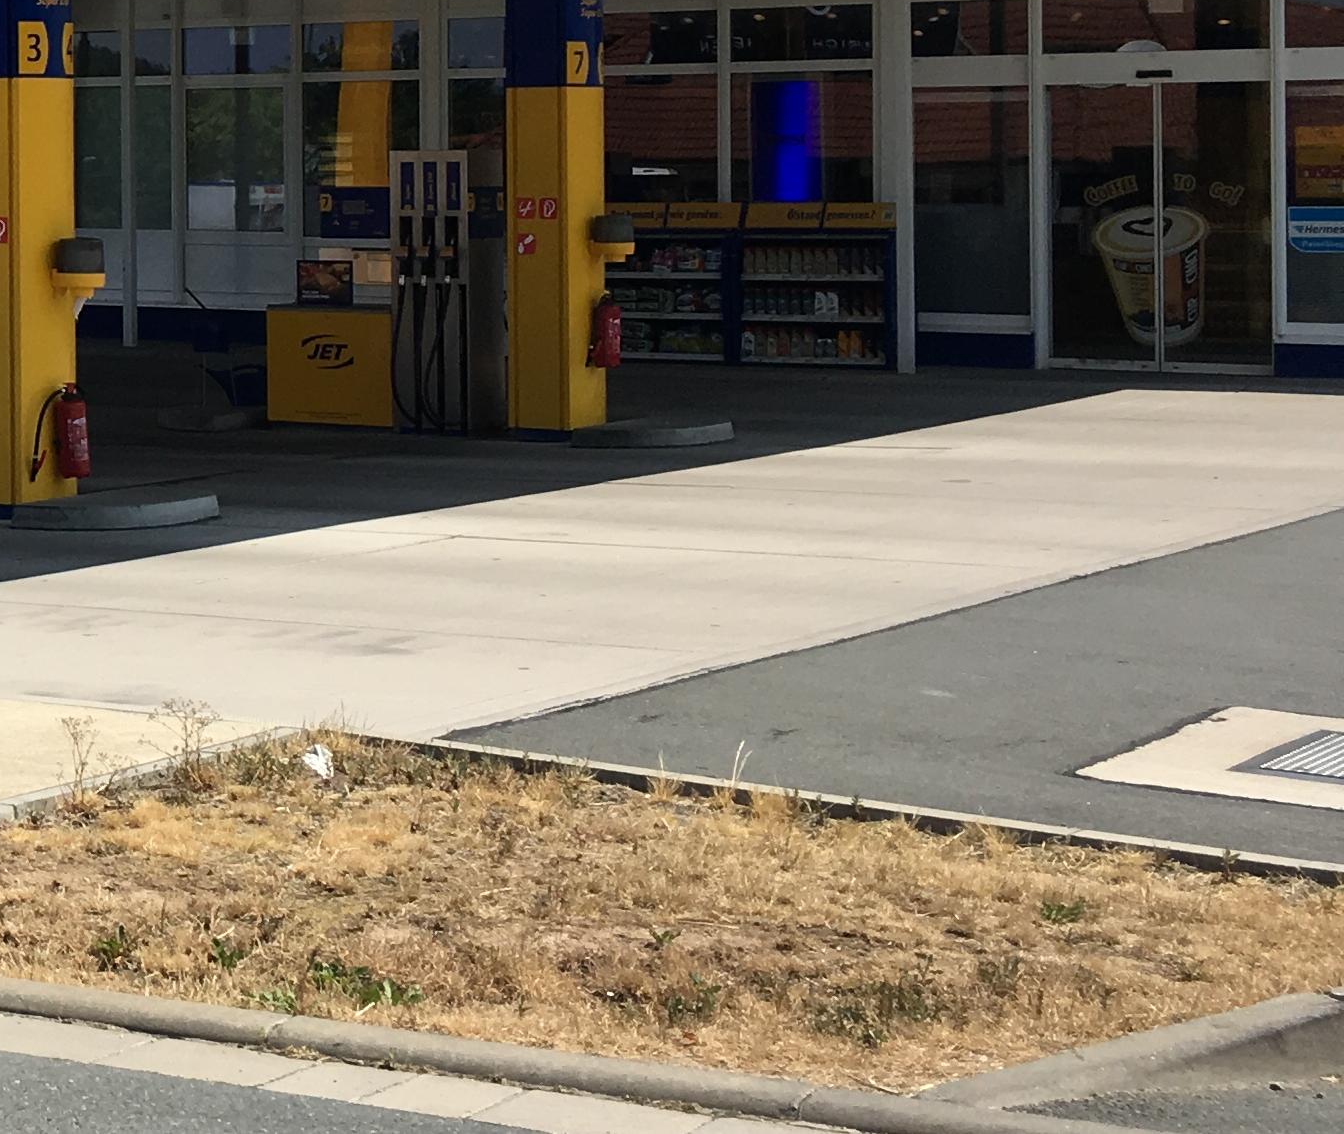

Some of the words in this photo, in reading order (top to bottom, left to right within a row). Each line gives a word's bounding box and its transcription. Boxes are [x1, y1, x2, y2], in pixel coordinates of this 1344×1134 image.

[26, 33, 41, 62] 3
[574, 50, 584, 74] 7
[310, 344, 348, 360] JET
